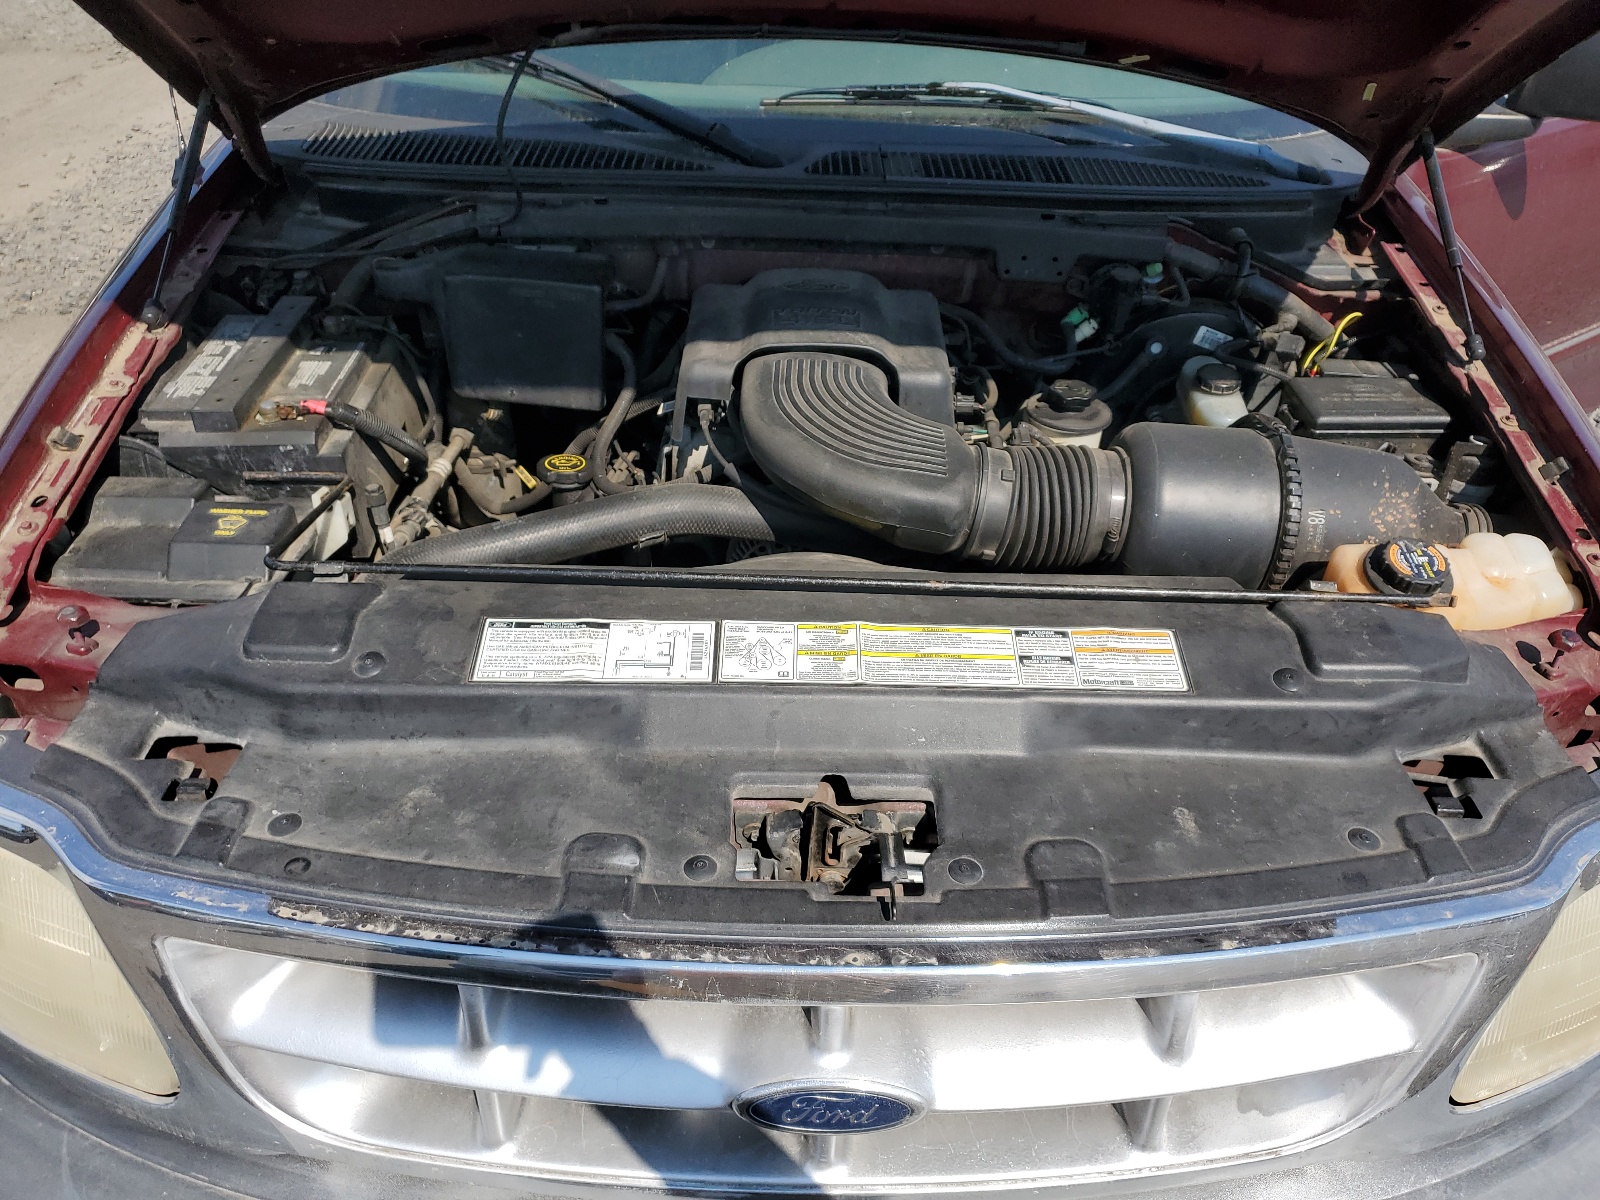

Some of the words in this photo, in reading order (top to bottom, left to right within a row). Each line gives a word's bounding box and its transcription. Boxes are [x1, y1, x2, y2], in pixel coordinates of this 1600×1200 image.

[1307, 510, 1326, 525] V8
[1082, 678, 1120, 686] Motorcraft
[782, 1095, 880, 1124] Ford
